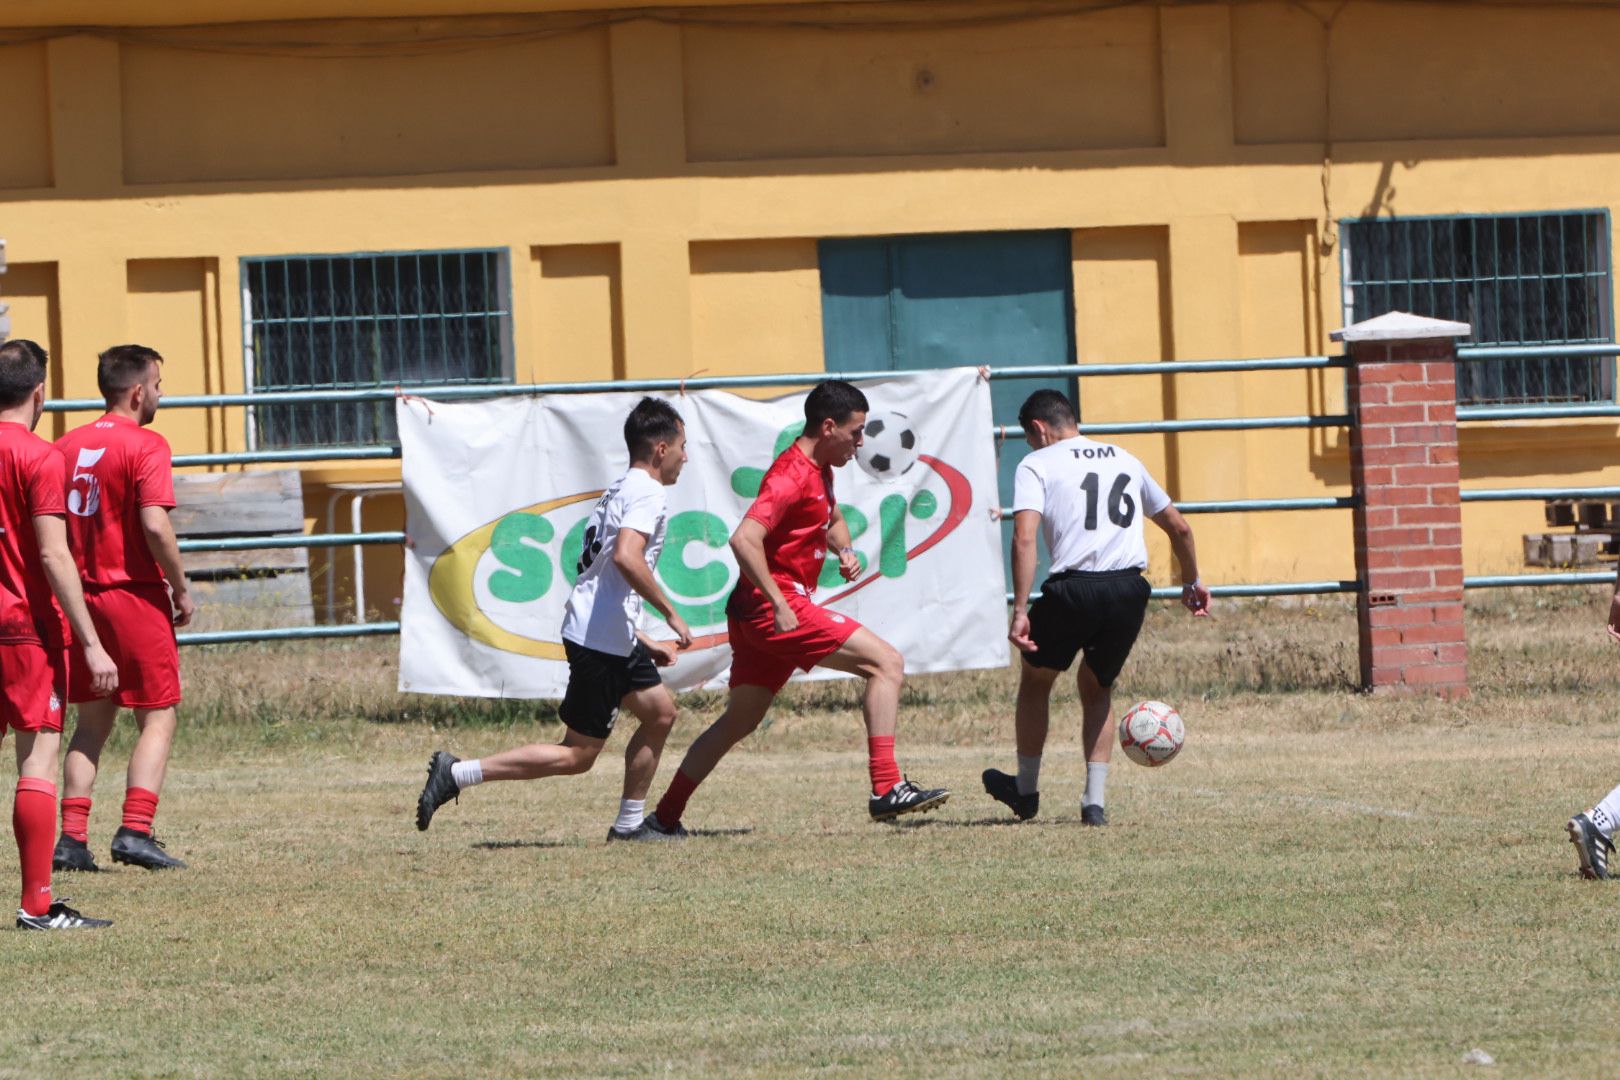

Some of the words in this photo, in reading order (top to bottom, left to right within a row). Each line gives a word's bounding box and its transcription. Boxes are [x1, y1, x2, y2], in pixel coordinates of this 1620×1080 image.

[67, 447, 107, 517] 5
[1070, 446, 1116, 460] TOM
[1079, 471, 1136, 531] 16
